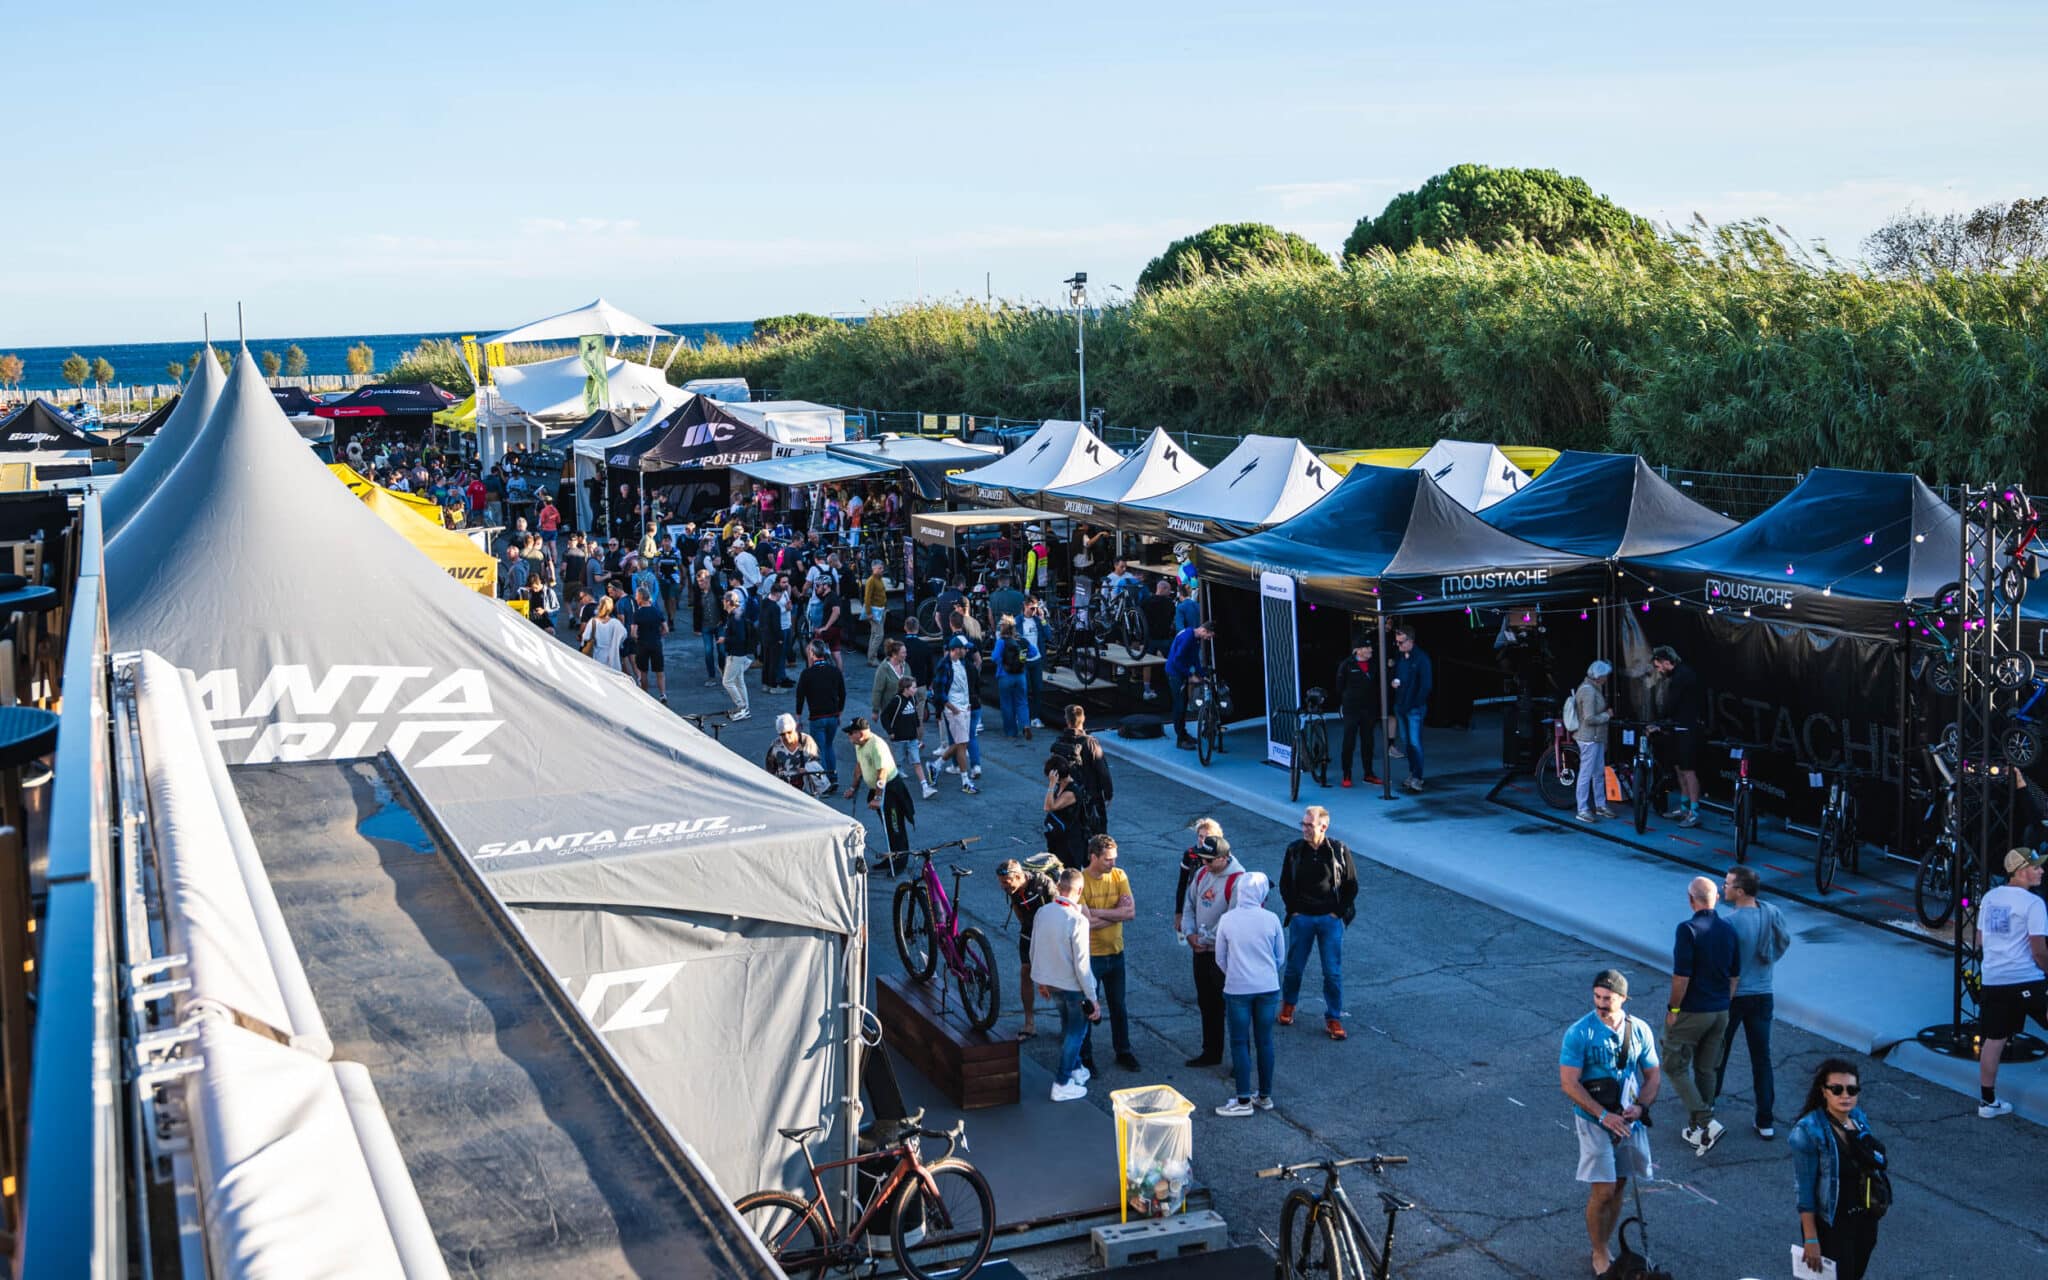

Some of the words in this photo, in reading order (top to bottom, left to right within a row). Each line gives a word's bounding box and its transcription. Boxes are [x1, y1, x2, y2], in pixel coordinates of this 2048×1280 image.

[1167, 517, 1204, 533] SPECIALIZED
[442, 566, 488, 579] AVIC
[1442, 569, 1548, 600] MOUSTACHE
[196, 664, 494, 719] ANTA
[473, 832, 617, 860] SANTA
[623, 815, 731, 842] CRUZ
